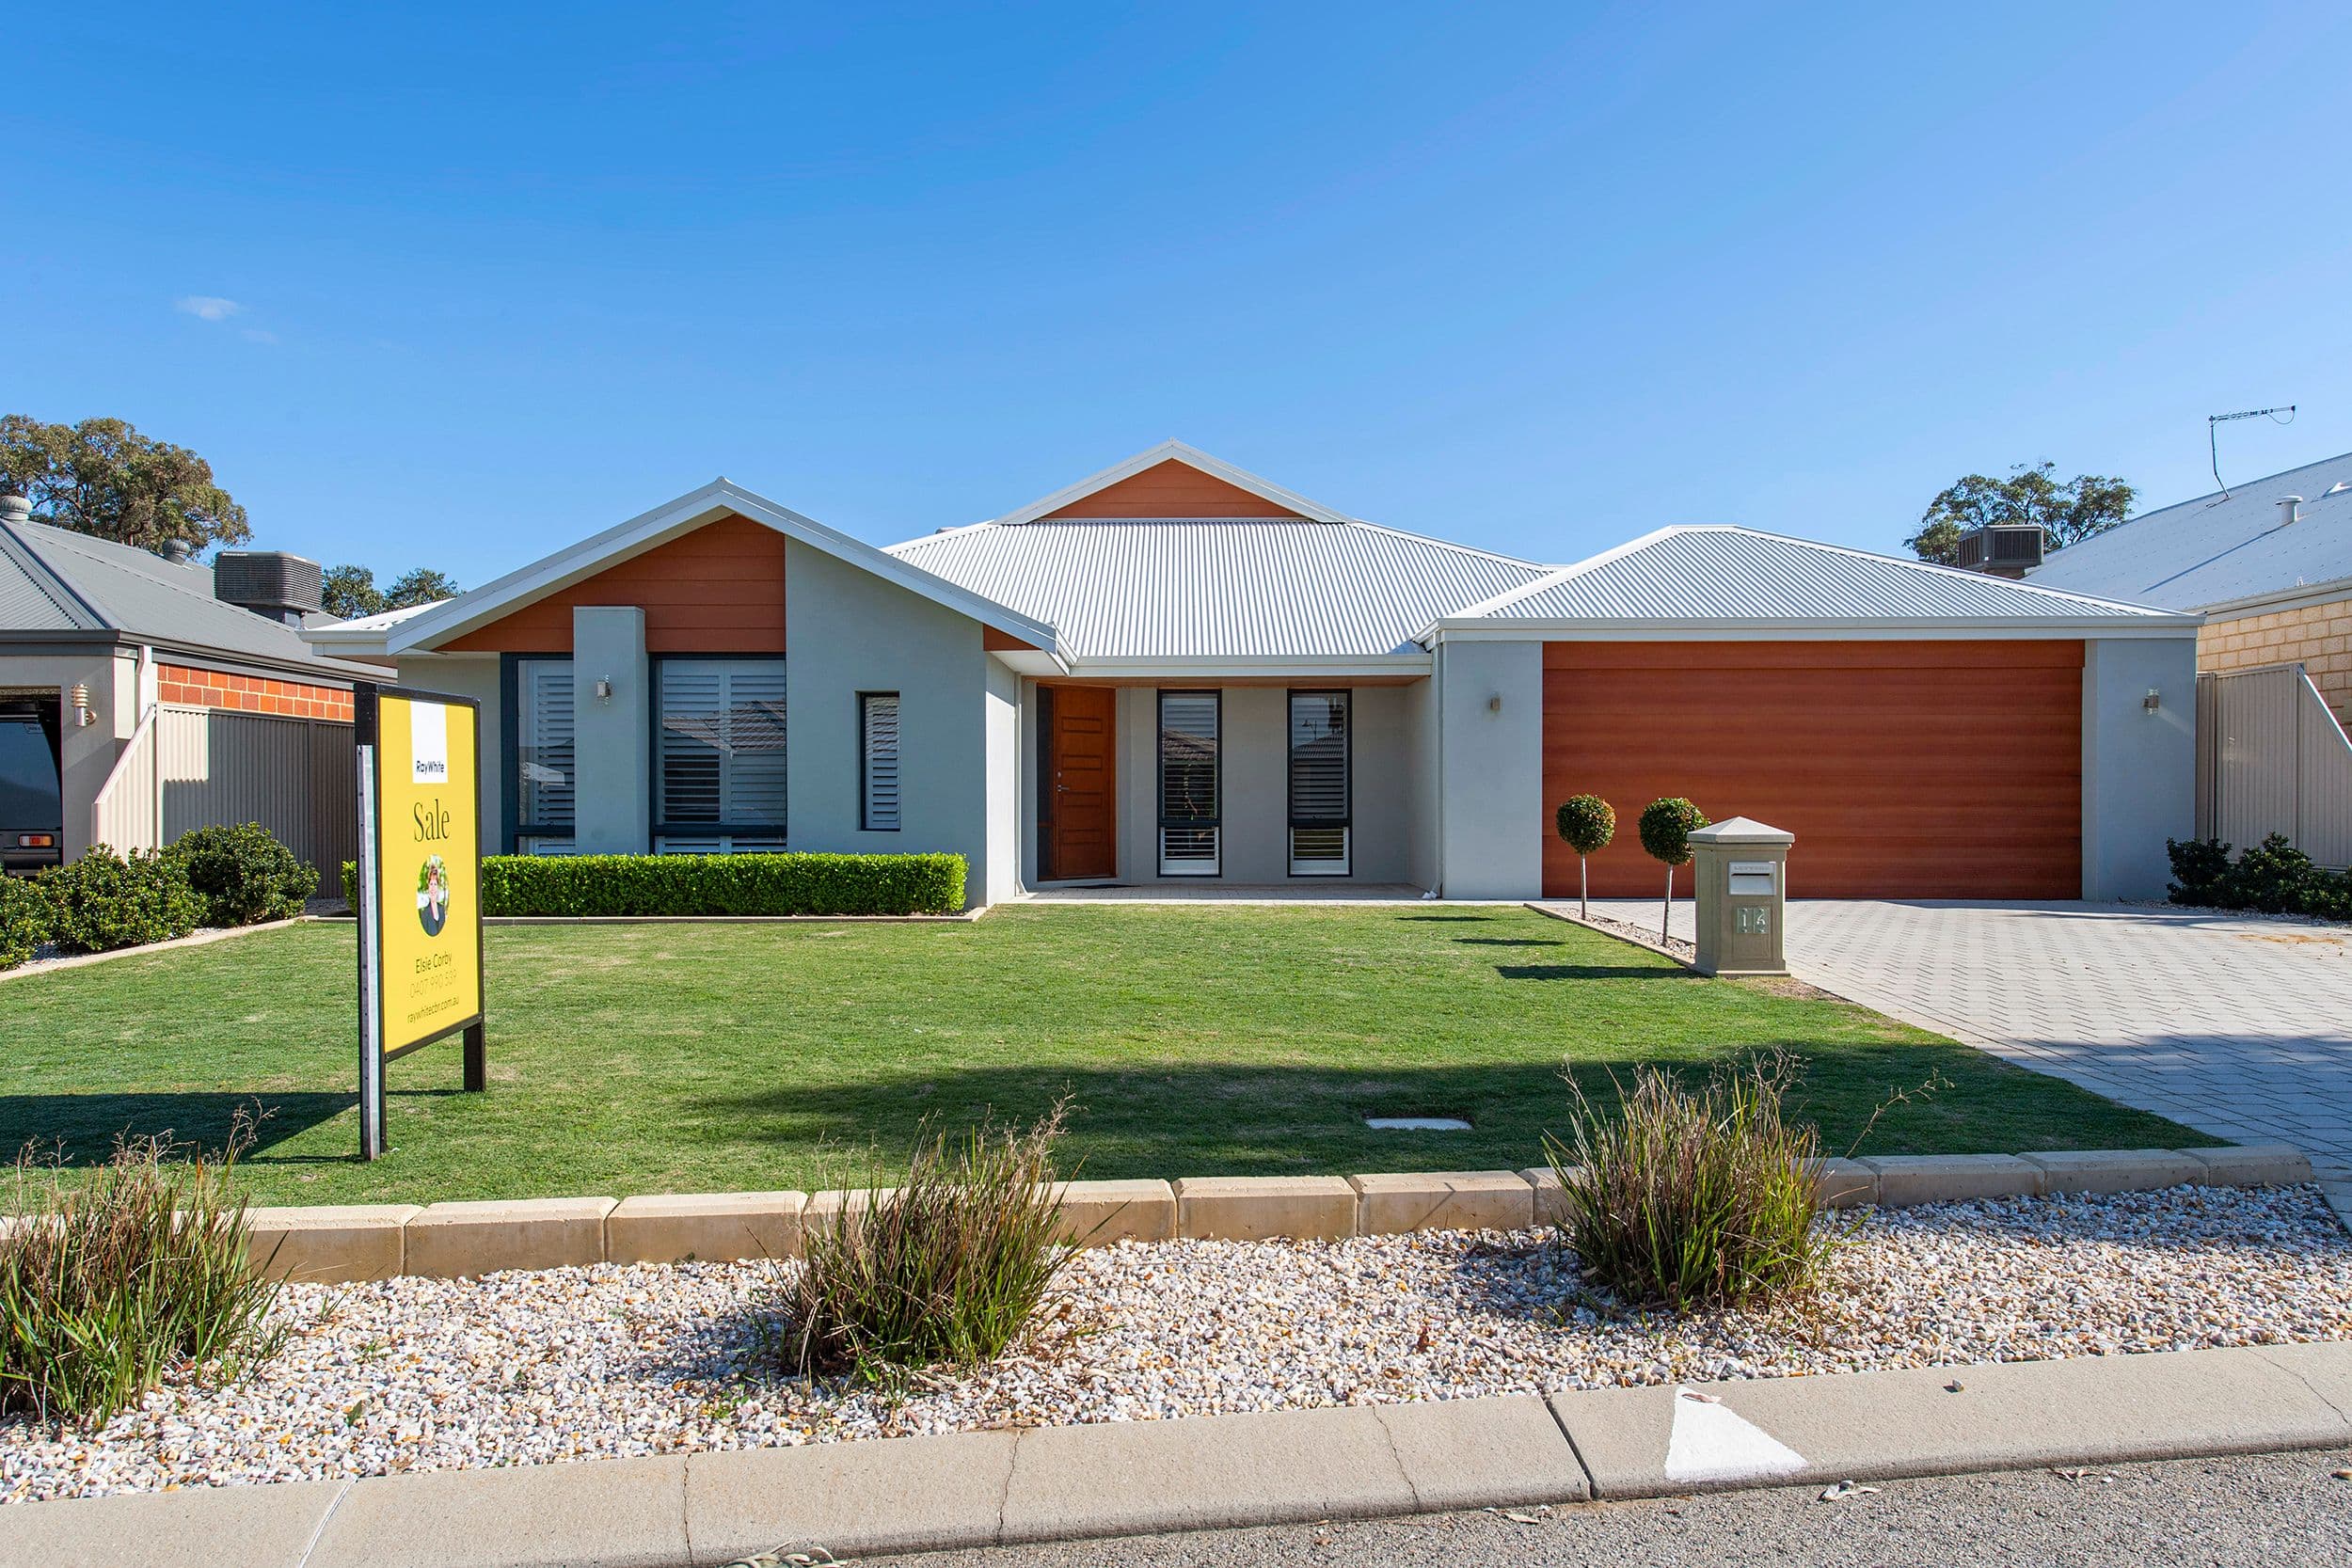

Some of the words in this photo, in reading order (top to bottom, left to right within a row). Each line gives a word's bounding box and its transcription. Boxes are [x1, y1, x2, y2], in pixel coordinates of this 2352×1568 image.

[413, 798, 451, 843] Sale
[416, 956, 432, 974] Elsie
[433, 950, 453, 969] Corby
